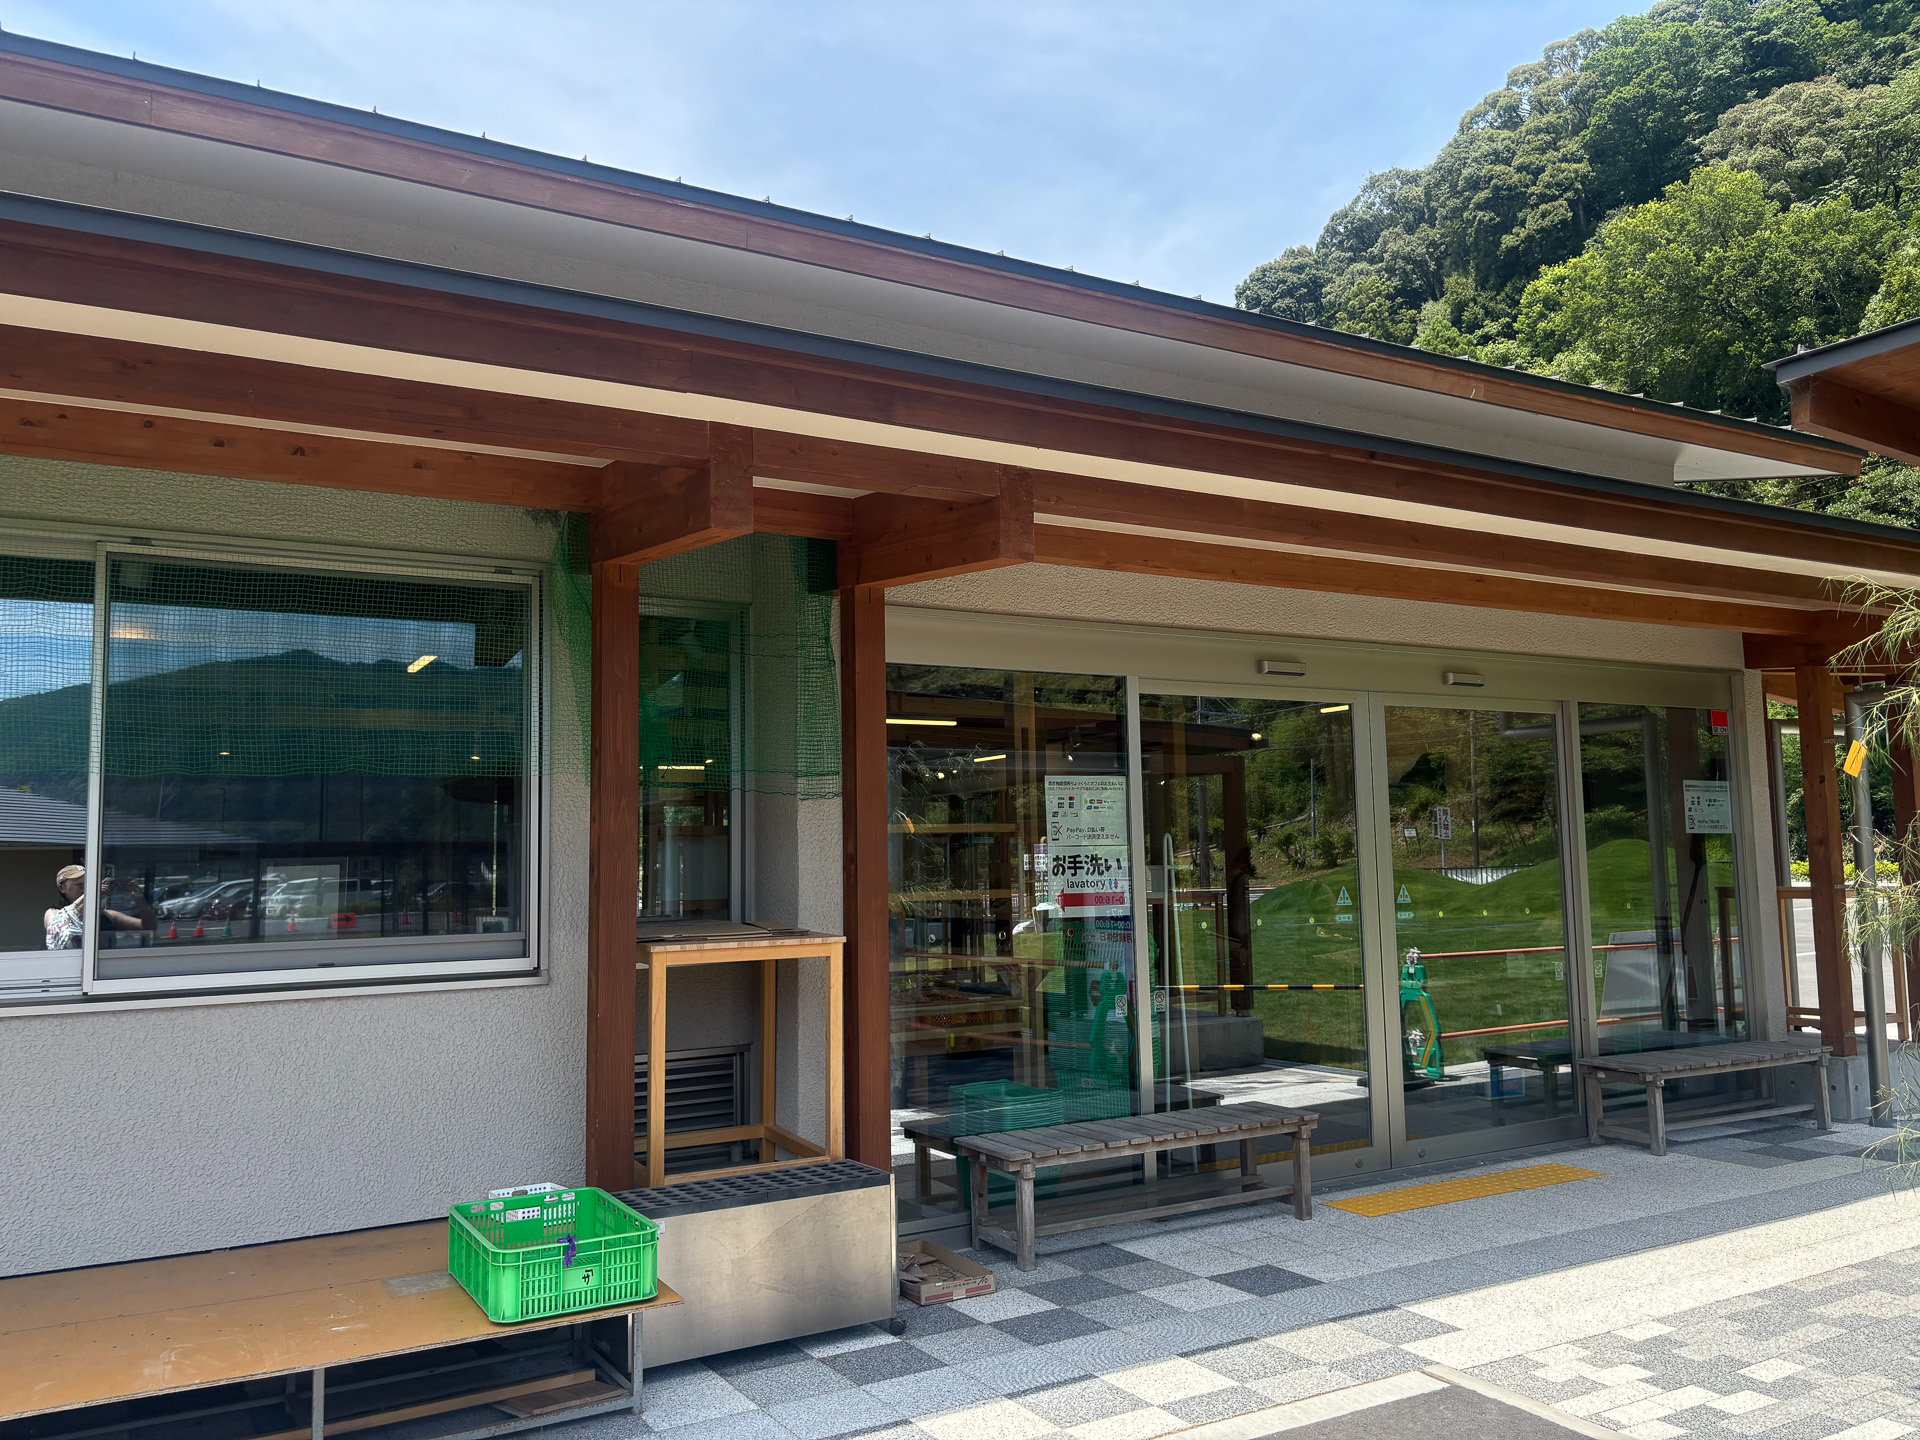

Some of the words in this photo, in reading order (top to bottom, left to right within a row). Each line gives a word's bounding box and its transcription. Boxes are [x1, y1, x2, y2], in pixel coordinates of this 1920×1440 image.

[1052, 854, 1122, 877] お手洗い
[1066, 878, 1106, 890] lavatory
